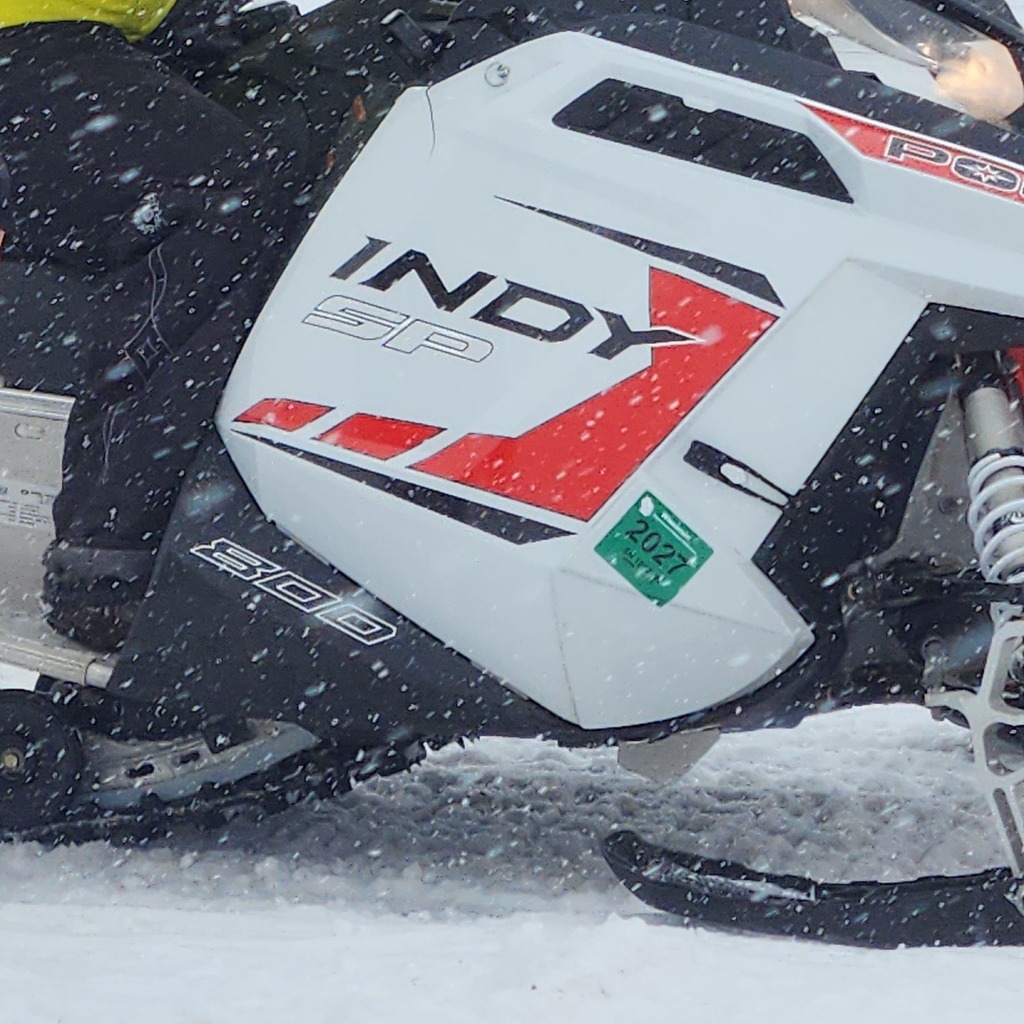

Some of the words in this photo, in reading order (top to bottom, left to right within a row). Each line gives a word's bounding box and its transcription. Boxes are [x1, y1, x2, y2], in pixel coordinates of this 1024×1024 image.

[884, 134, 1024, 196] PO
[302, 294, 495, 364] SP
[330, 235, 706, 361] INDY
[625, 519, 692, 575] 2027
[189, 537, 398, 645] 800
